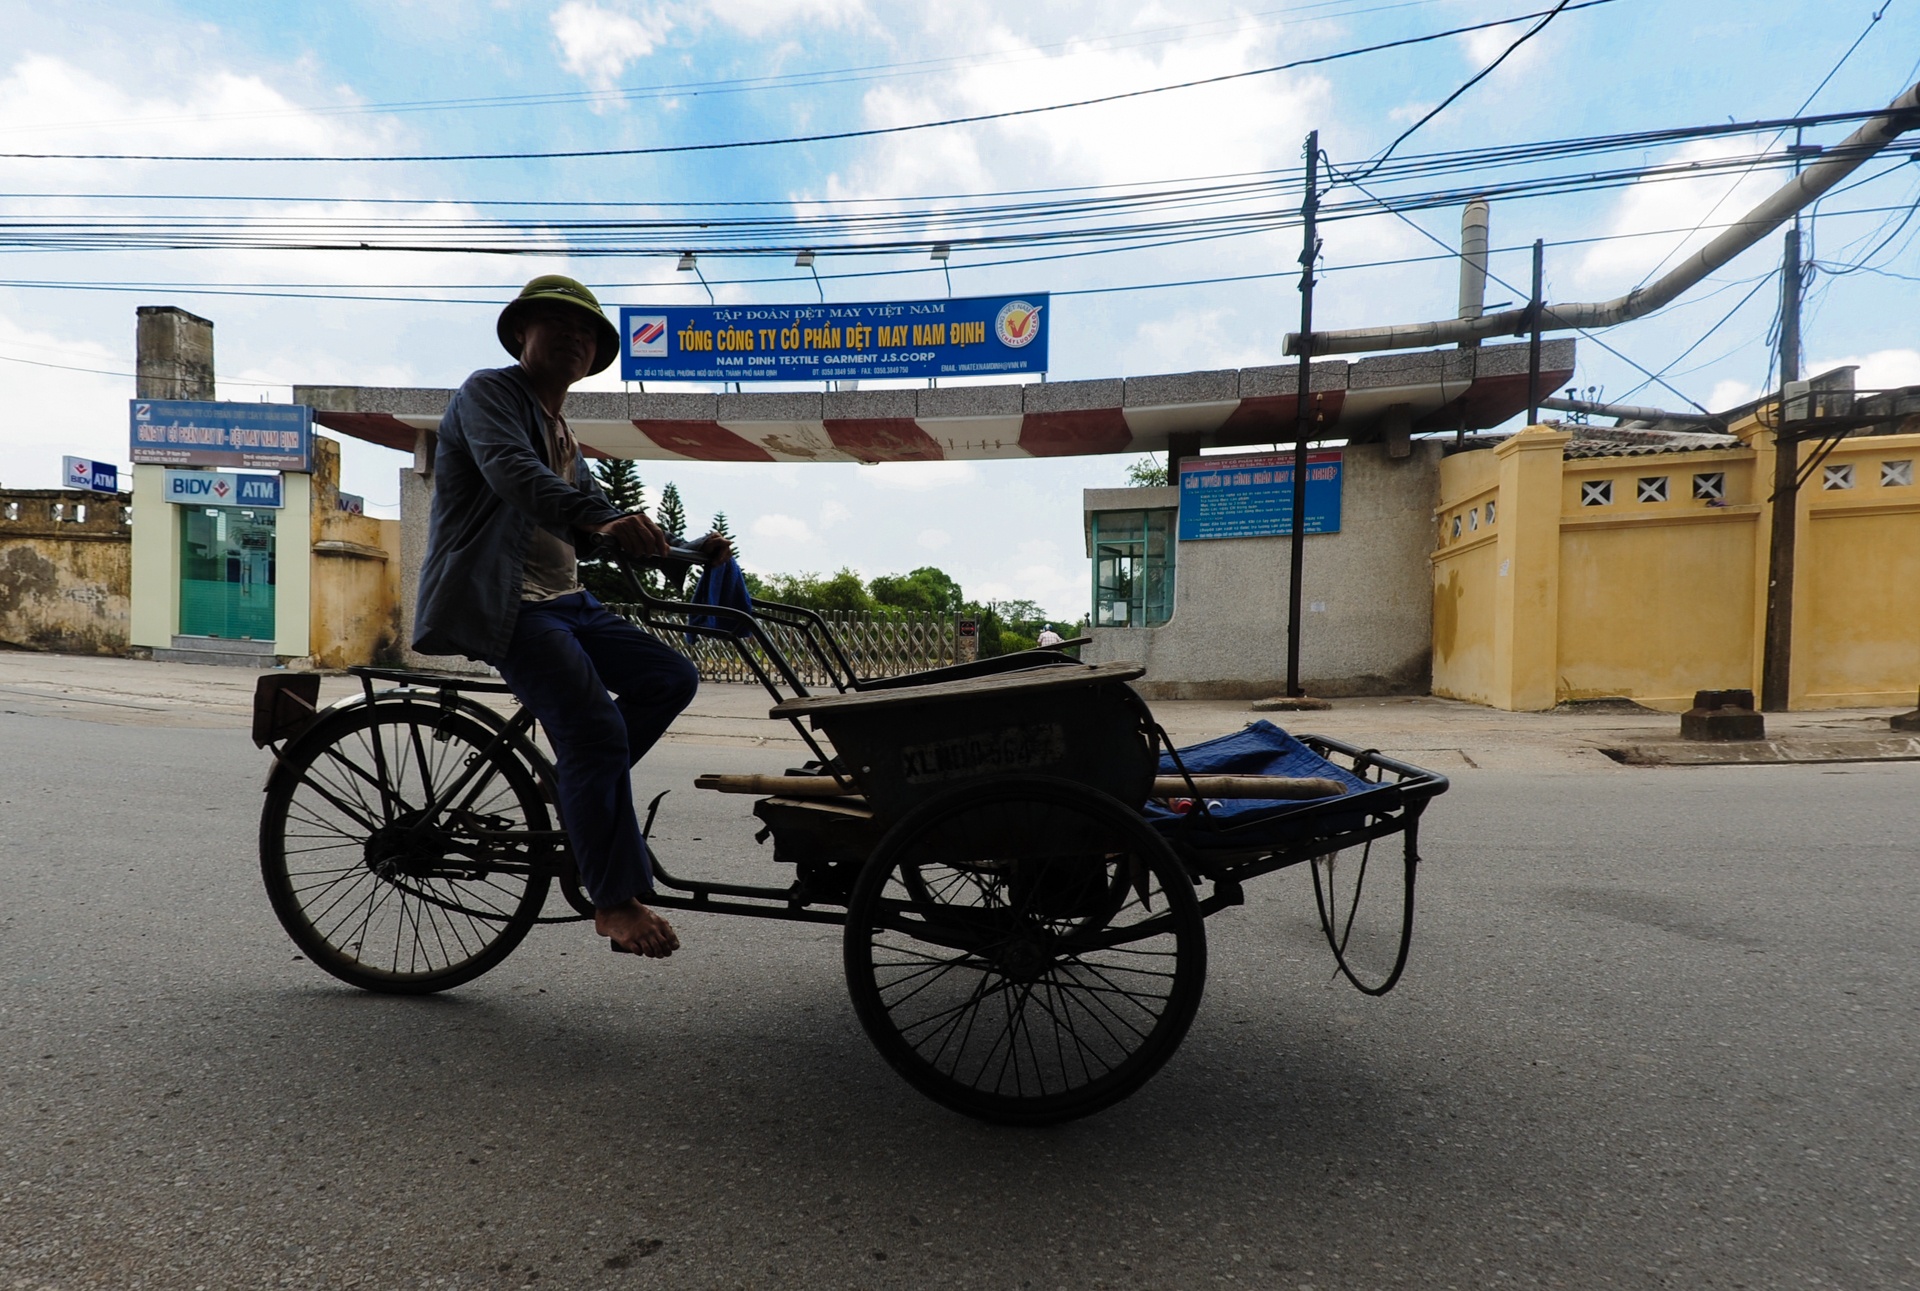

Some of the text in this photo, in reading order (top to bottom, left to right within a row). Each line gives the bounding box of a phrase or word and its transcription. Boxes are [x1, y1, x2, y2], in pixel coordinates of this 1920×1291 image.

[713, 304, 945, 322] TẬP ĐOÀN DỆT MAY VIỆT NAM
[677, 319, 984, 351] TỔNG CÔNG TY CỔ PHẦN DỆT MAY NAM ĐỊNH
[716, 352, 936, 366] NAM DINH TEXTILE GARMENT J.S.CORP
[260, 430, 279, 448] NAM
[70, 472, 115, 488] BIDV ATM
[173, 478, 274, 499] BIDV ATM
